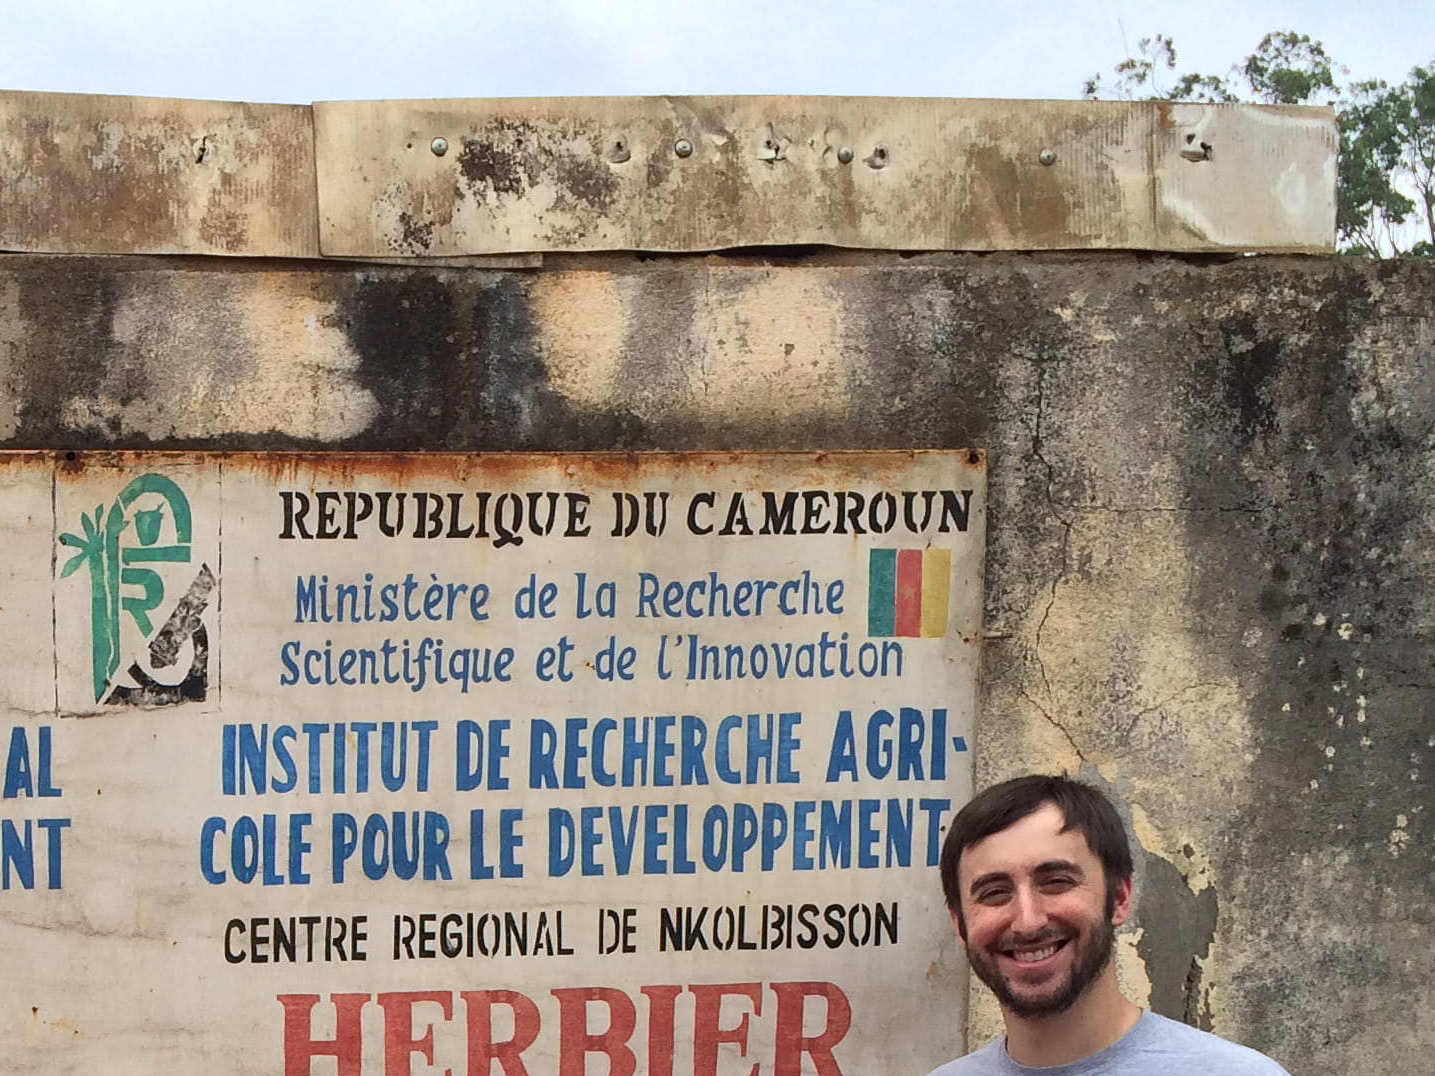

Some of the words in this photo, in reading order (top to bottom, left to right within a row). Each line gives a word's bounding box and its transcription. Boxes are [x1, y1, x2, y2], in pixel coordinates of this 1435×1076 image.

[279, 491, 591, 548] REPUBLIQUE
[611, 492, 670, 538] DU
[687, 489, 973, 537] CAMEROUN
[294, 573, 490, 623] Ministère
[515, 574, 557, 619] de
[575, 572, 617, 619] la
[636, 570, 845, 618] Recherche
[280, 637, 515, 693] Scientifique
[536, 636, 574, 682] et
[595, 636, 637, 681] de
[221, 720, 438, 795] INSTITUT
[456, 719, 511, 792] DE
[528, 711, 802, 790] RECHERCHE
[825, 707, 968, 783] AGRI-
[200, 813, 312, 885] COLE
[332, 810, 453, 884] POUR
[469, 808, 524, 880] LE
[548, 798, 951, 878] DEVELOPPEMENT
[224, 915, 367, 963] CENTRE
[393, 910, 574, 960] REGIONAL
[598, 907, 637, 954] DE
[659, 902, 899, 952] NKOLBISSON
